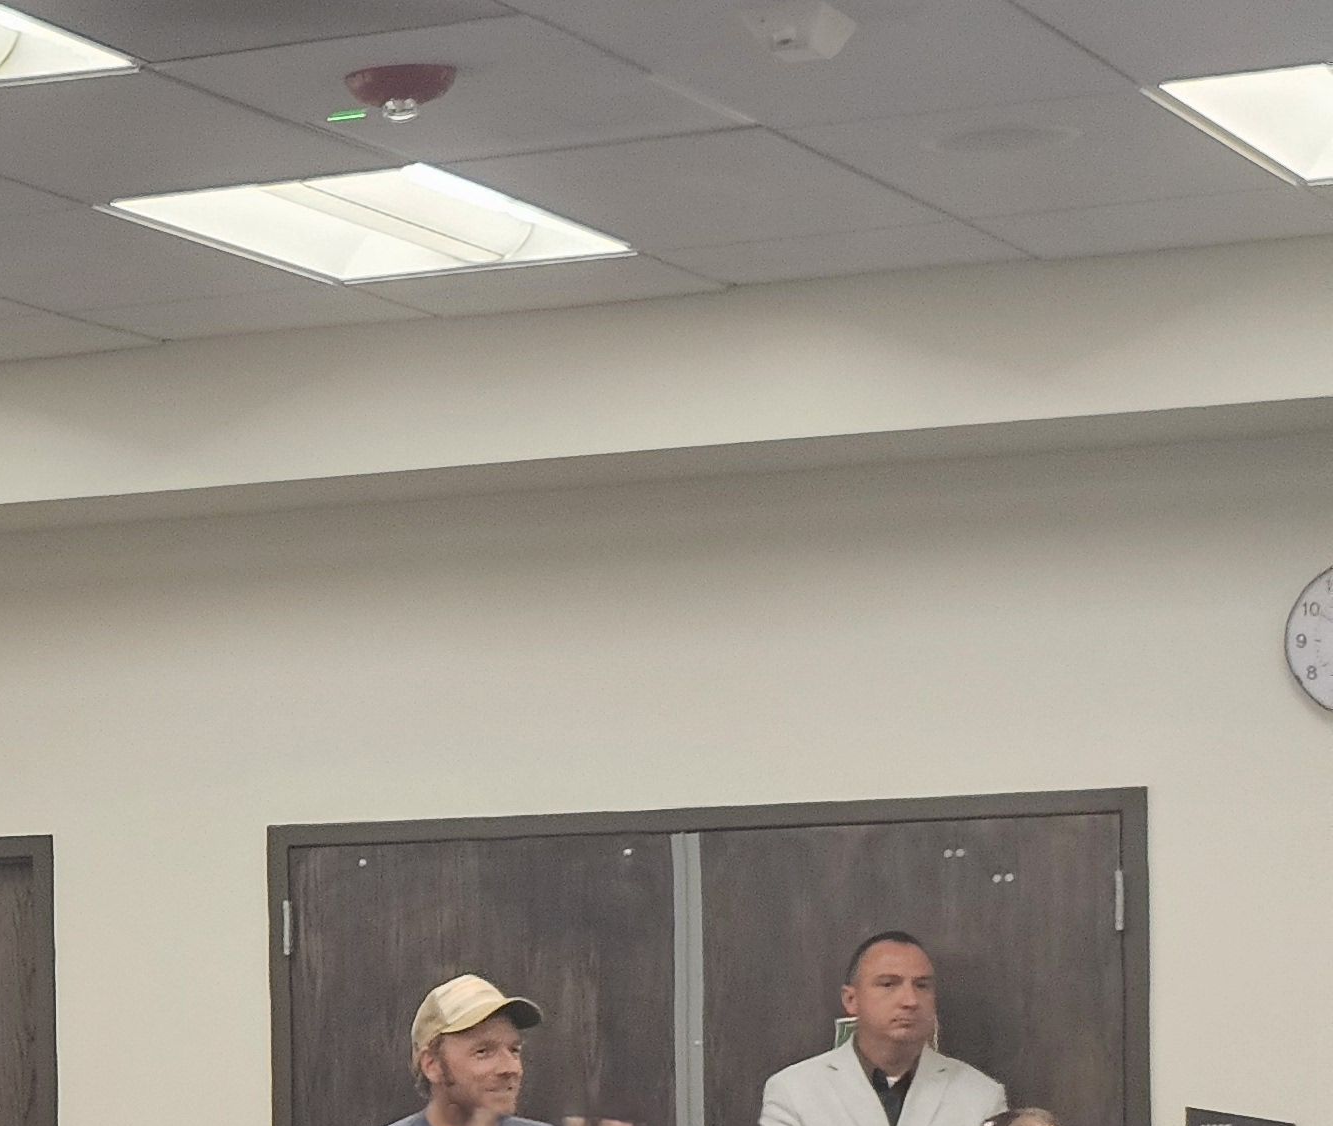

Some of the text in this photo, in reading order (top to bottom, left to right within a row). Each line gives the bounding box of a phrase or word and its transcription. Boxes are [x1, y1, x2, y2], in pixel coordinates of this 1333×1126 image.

[1302, 601, 1320, 617] 10
[1295, 633, 1307, 649] 9
[1306, 664, 1318, 681] 8
